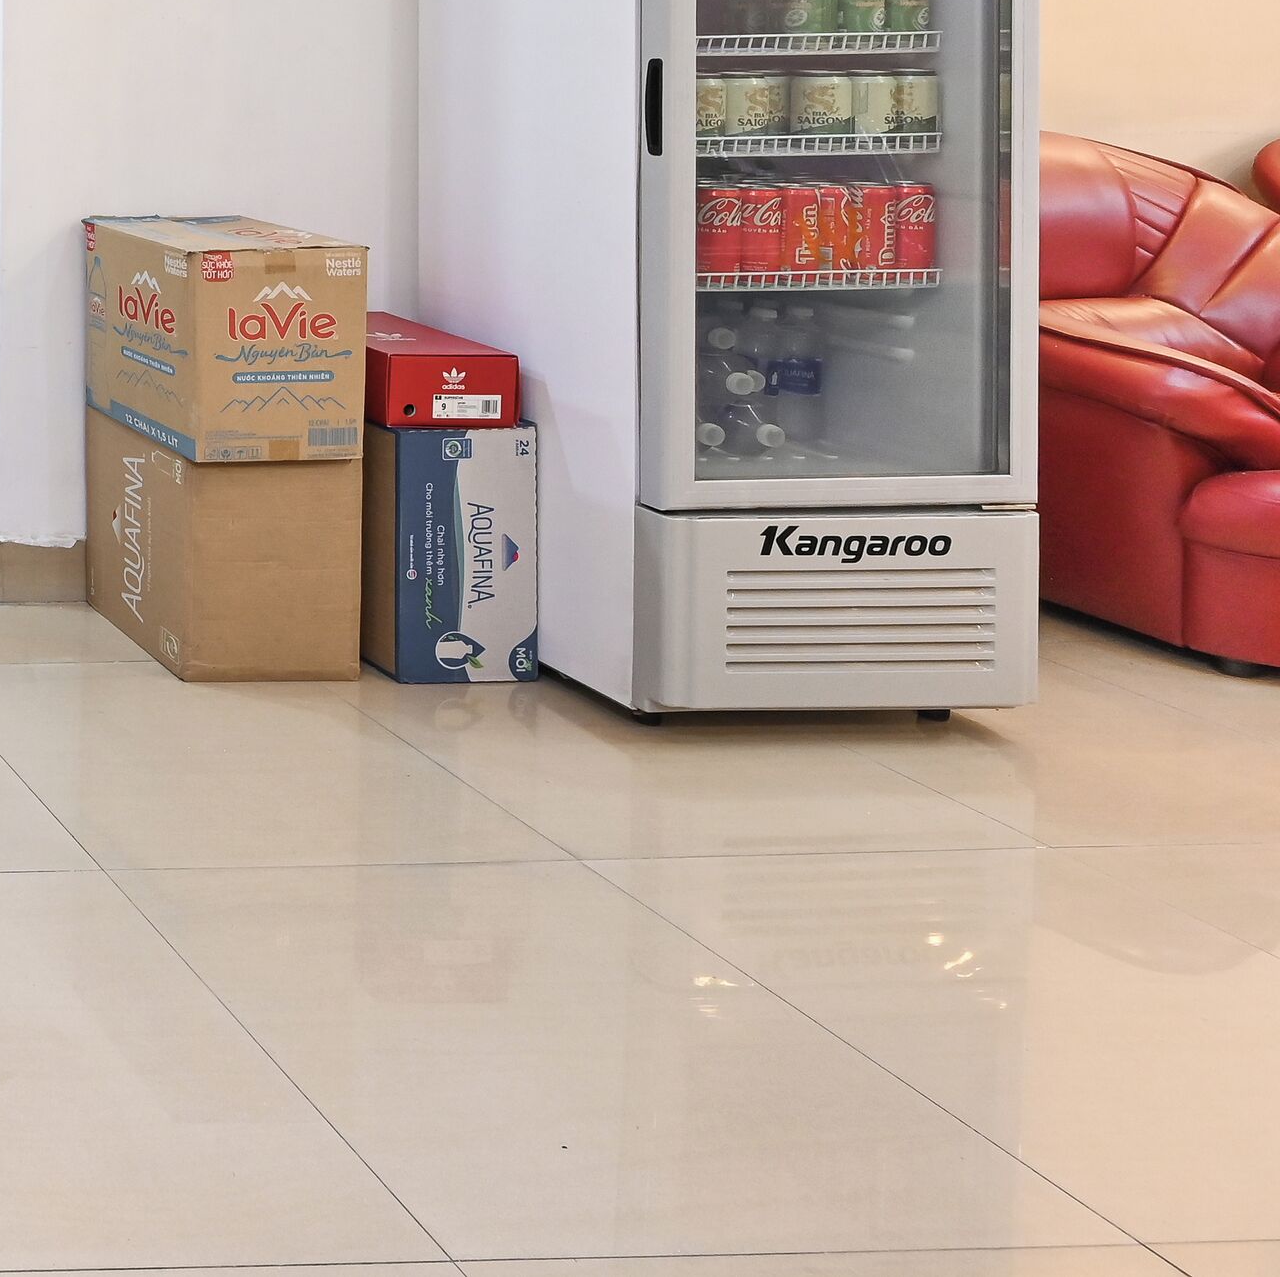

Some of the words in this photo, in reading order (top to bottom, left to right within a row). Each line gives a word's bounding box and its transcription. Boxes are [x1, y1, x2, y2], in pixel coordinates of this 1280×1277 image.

[797, 115, 843, 124] SAIGON
[165, 254, 187, 269] Nestlé
[326, 258, 361, 267] Nestlé
[326, 268, 361, 276] Waters
[202, 270, 216, 278] TỐT
[218, 269, 233, 279] HƠN
[119, 286, 175, 333] laVie
[228, 302, 337, 341] laVie
[227, 345, 295, 365] Nguyên
[294, 343, 329, 361] Bản
[125, 414, 133, 424] 12
[134, 418, 149, 434] CHAI
[151, 427, 156, 436] X
[157, 430, 166, 442] 1,5
[168, 435, 178, 447] LÍT
[520, 440, 529, 456] 24
[425, 483, 433, 500] Cho
[425, 503, 433, 518] môi
[121, 457, 145, 623] AQUAFINA
[425, 520, 433, 549] trường
[437, 525, 445, 546] Chai
[759, 526, 951, 563] Kangaroo
[425, 551, 433, 575] thêm
[467, 502, 495, 604] AQUAFINA
[425, 577, 442, 630] xanh
